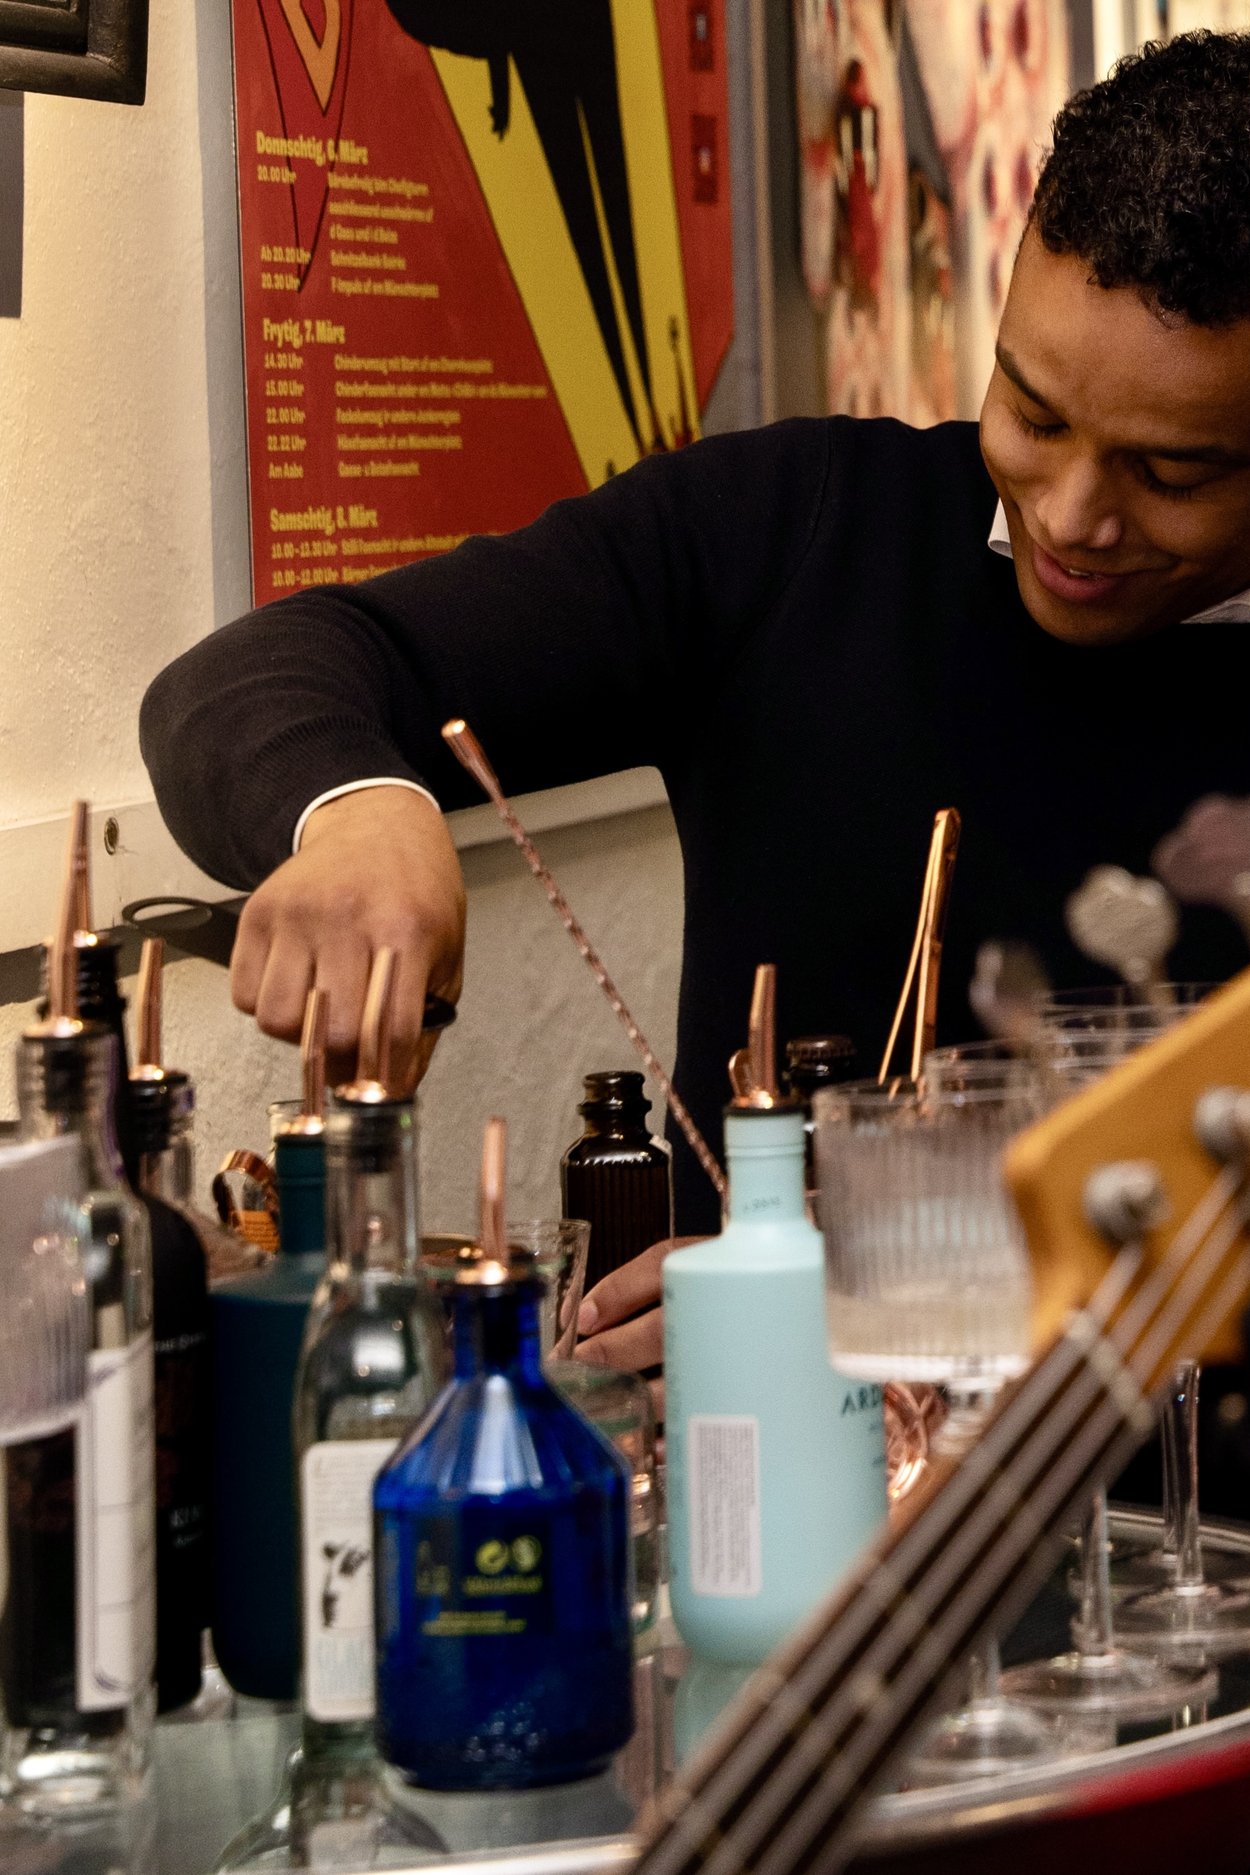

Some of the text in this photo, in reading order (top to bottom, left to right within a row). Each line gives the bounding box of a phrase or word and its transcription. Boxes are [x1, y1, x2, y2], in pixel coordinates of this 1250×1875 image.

[263, 318, 303, 349] Frytig,
[316, 319, 345, 344] März
[270, 505, 335, 536] Samschtig,
